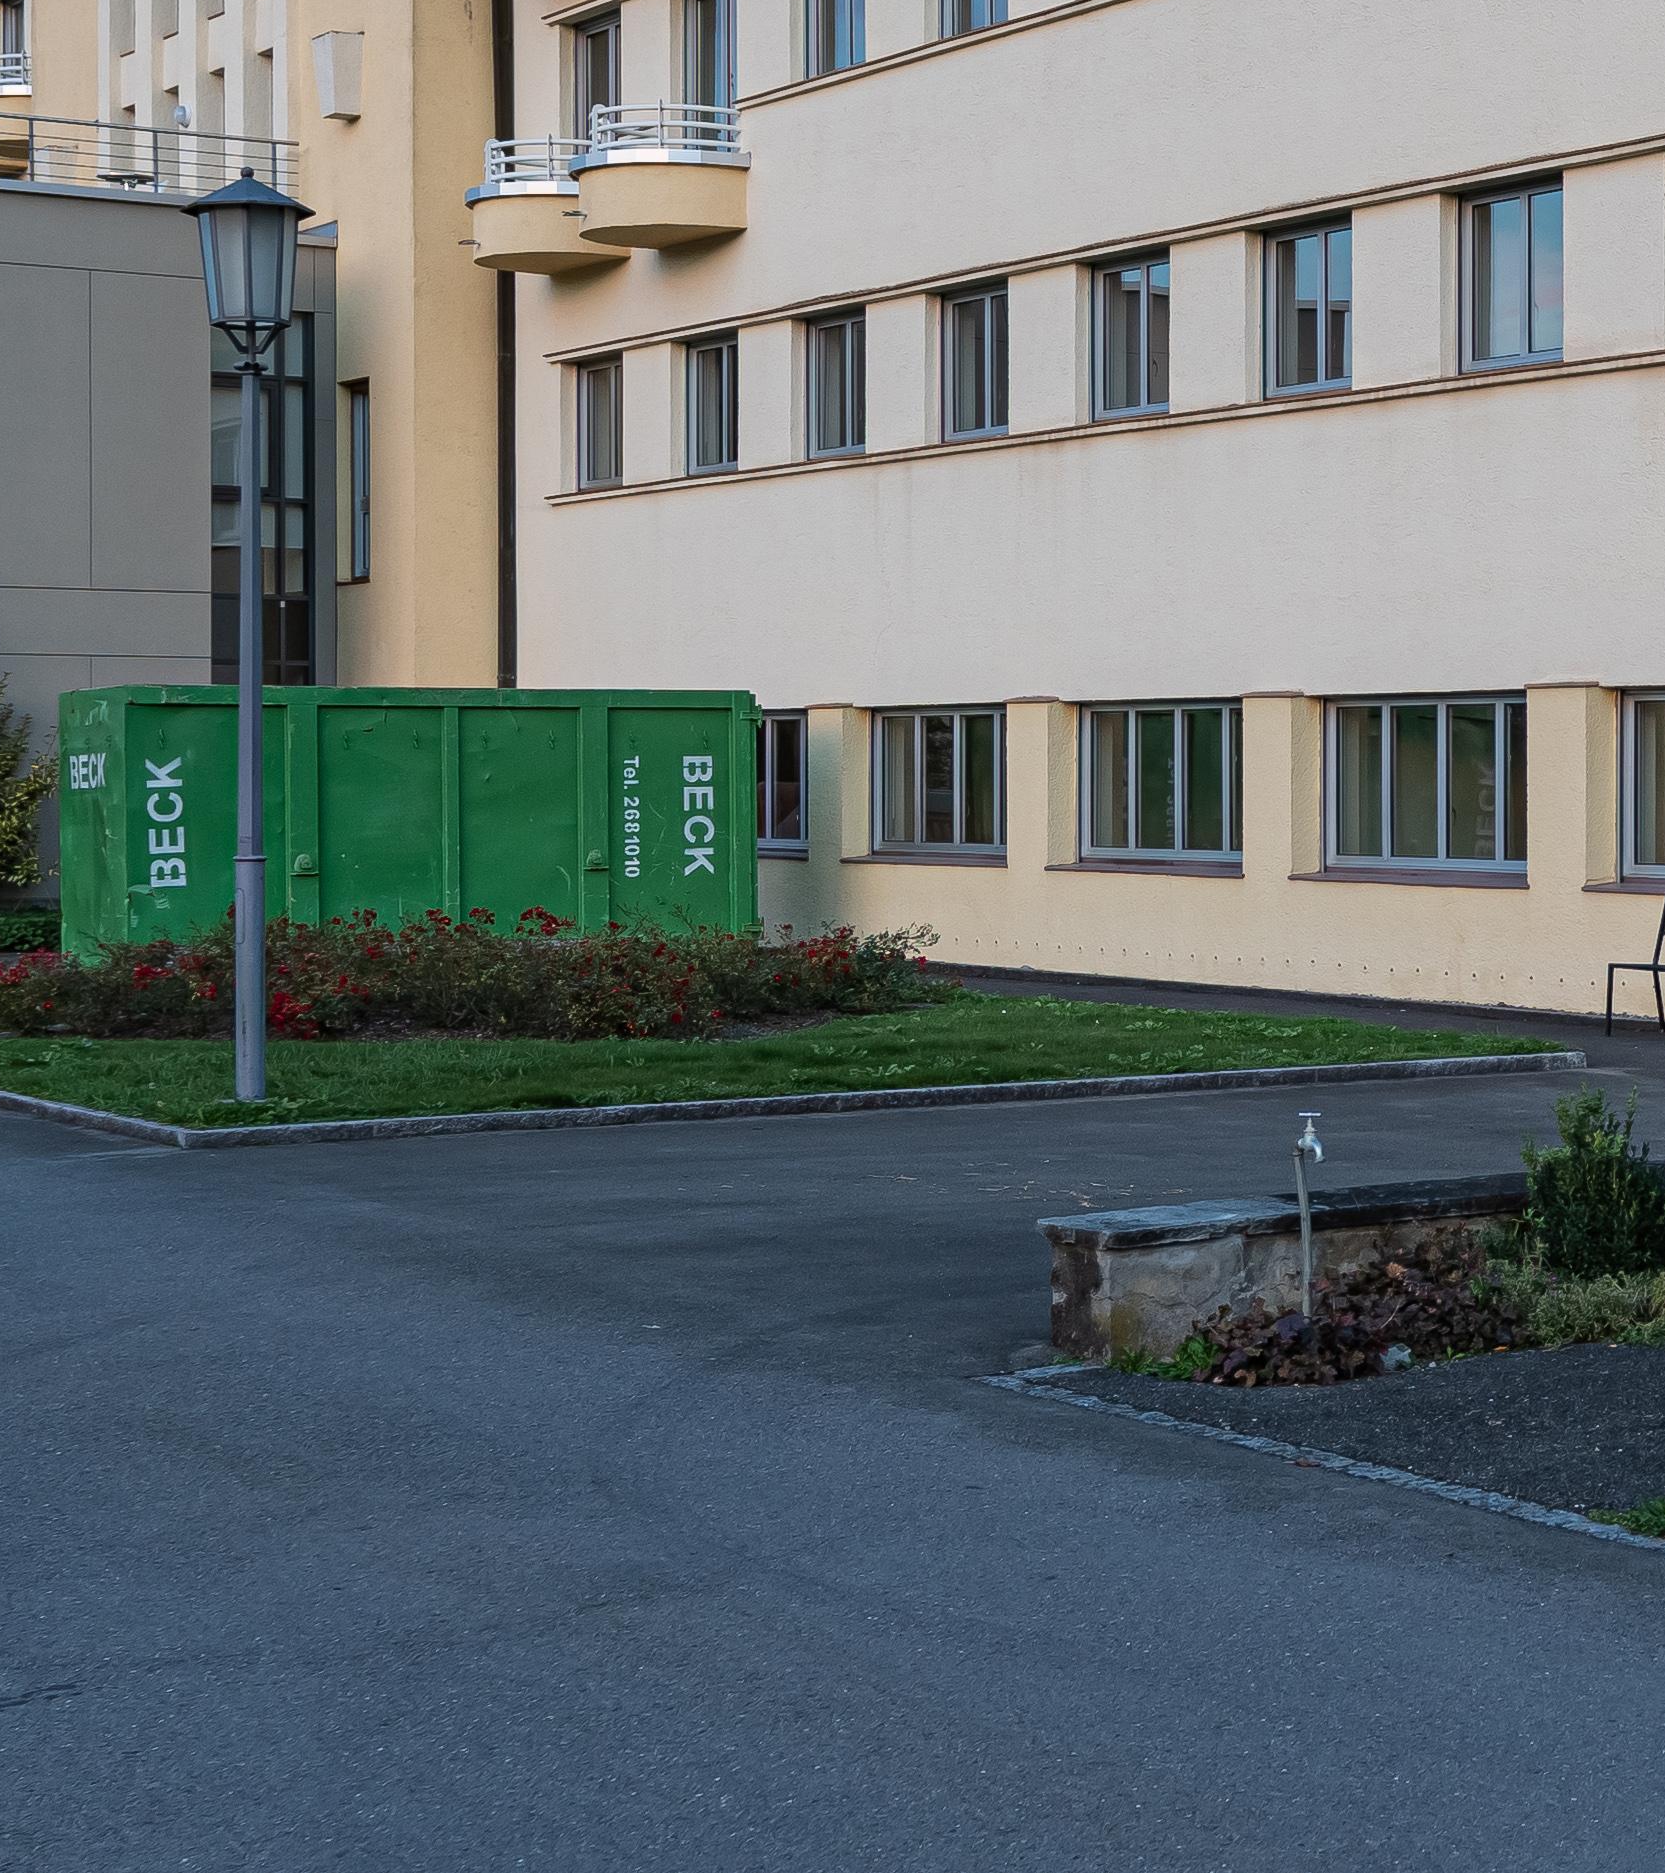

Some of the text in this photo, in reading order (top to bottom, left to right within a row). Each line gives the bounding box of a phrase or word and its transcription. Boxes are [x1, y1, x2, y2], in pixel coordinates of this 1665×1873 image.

[69, 752, 106, 789] BECK
[145, 756, 187, 888] BECK
[623, 755, 640, 878] Tel. 2681010
[683, 755, 714, 876] BECK
